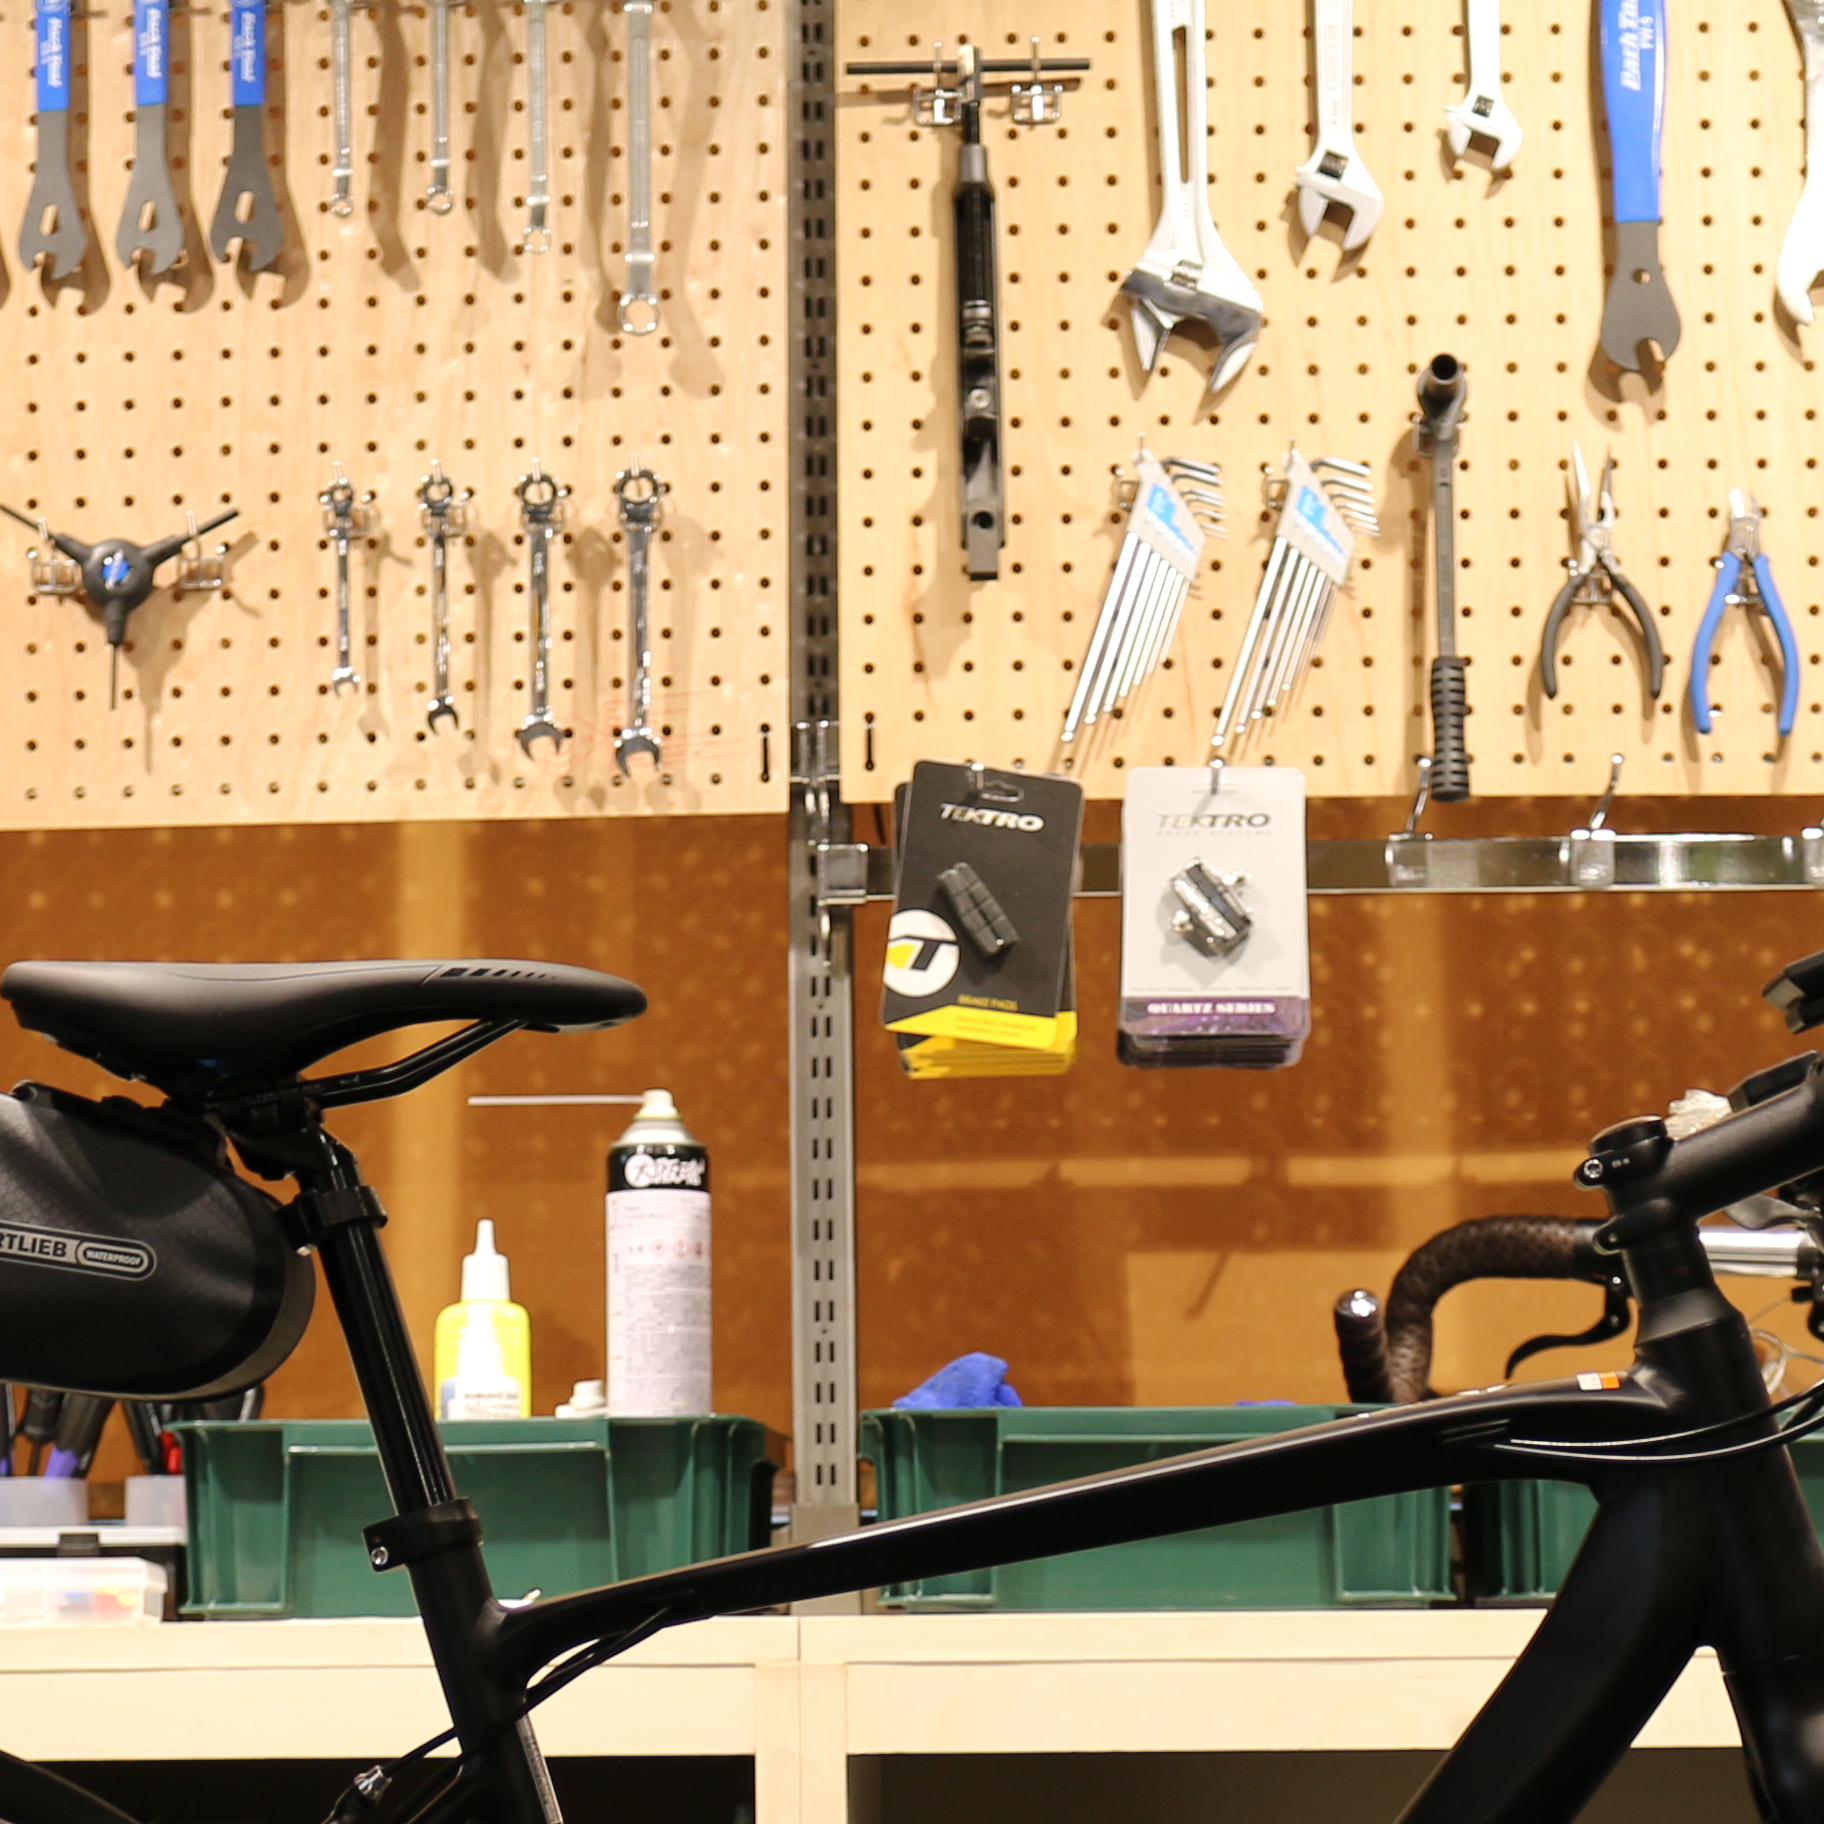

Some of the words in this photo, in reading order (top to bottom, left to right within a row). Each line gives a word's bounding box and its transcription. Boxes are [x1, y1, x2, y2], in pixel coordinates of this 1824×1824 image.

[940, 803, 1045, 832] TEKTRO
[1156, 813, 1272, 831] TEKTRO
[1147, 1002, 1214, 1015] QUARTZ
[1215, 1002, 1276, 1015] SERIES
[85, 1249, 142, 1267] WATERPROOF
